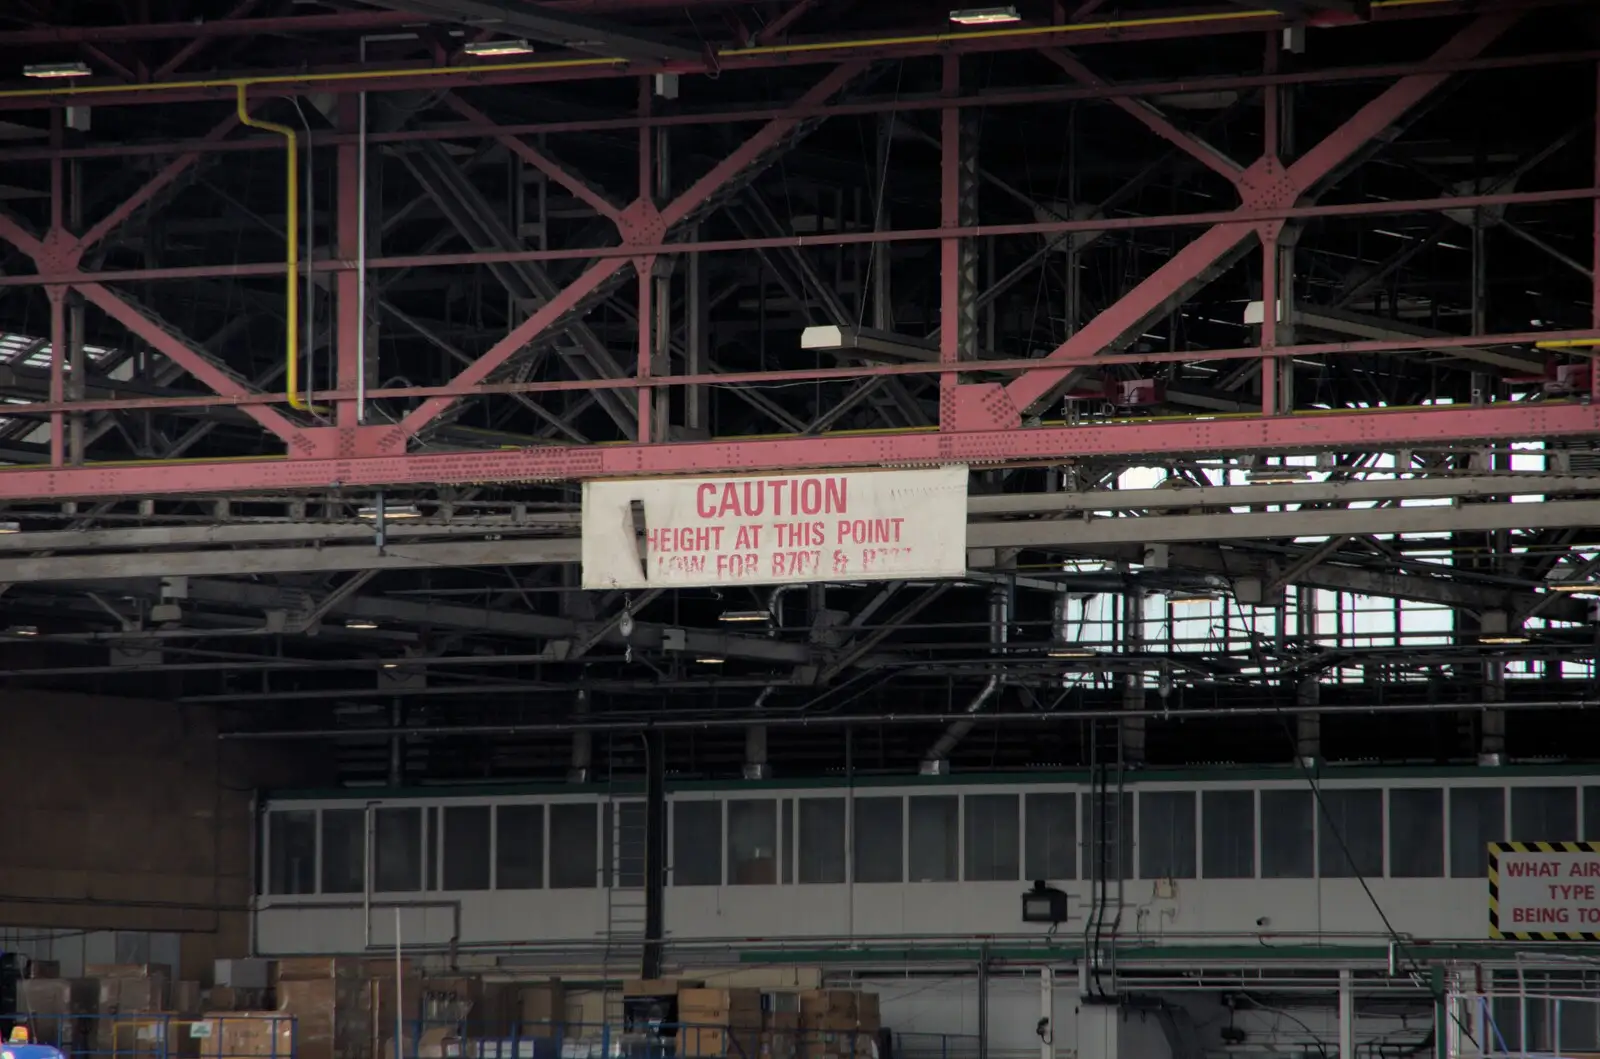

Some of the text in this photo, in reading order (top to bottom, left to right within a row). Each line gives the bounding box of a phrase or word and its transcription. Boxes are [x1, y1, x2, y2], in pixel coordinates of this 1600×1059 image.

[696, 477, 847, 518] CAUTION
[646, 518, 904, 552] HEIGHT AT THIS POINT
[716, 553, 759, 579] FOR
[1506, 862, 1561, 877] WHAT
[1548, 885, 1595, 900] TYPE
[1512, 907, 1569, 923] BEING
